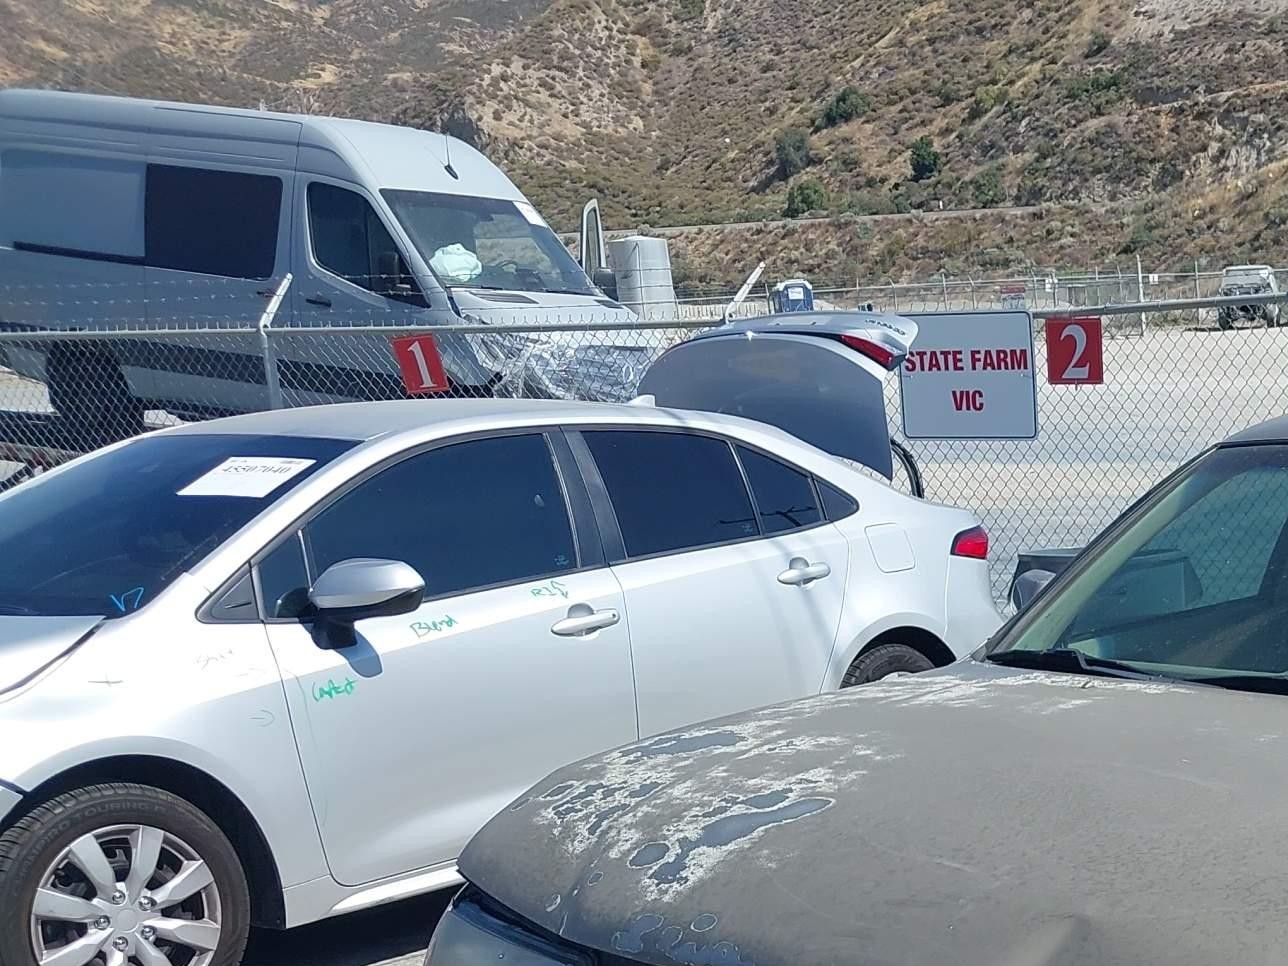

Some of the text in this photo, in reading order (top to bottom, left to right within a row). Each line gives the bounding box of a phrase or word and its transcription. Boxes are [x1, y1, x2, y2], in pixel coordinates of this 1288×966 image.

[408, 341, 438, 388] 1
[905, 349, 1029, 373] STATE FARM
[1060, 323, 1091, 379] 2
[951, 390, 985, 411] VIC
